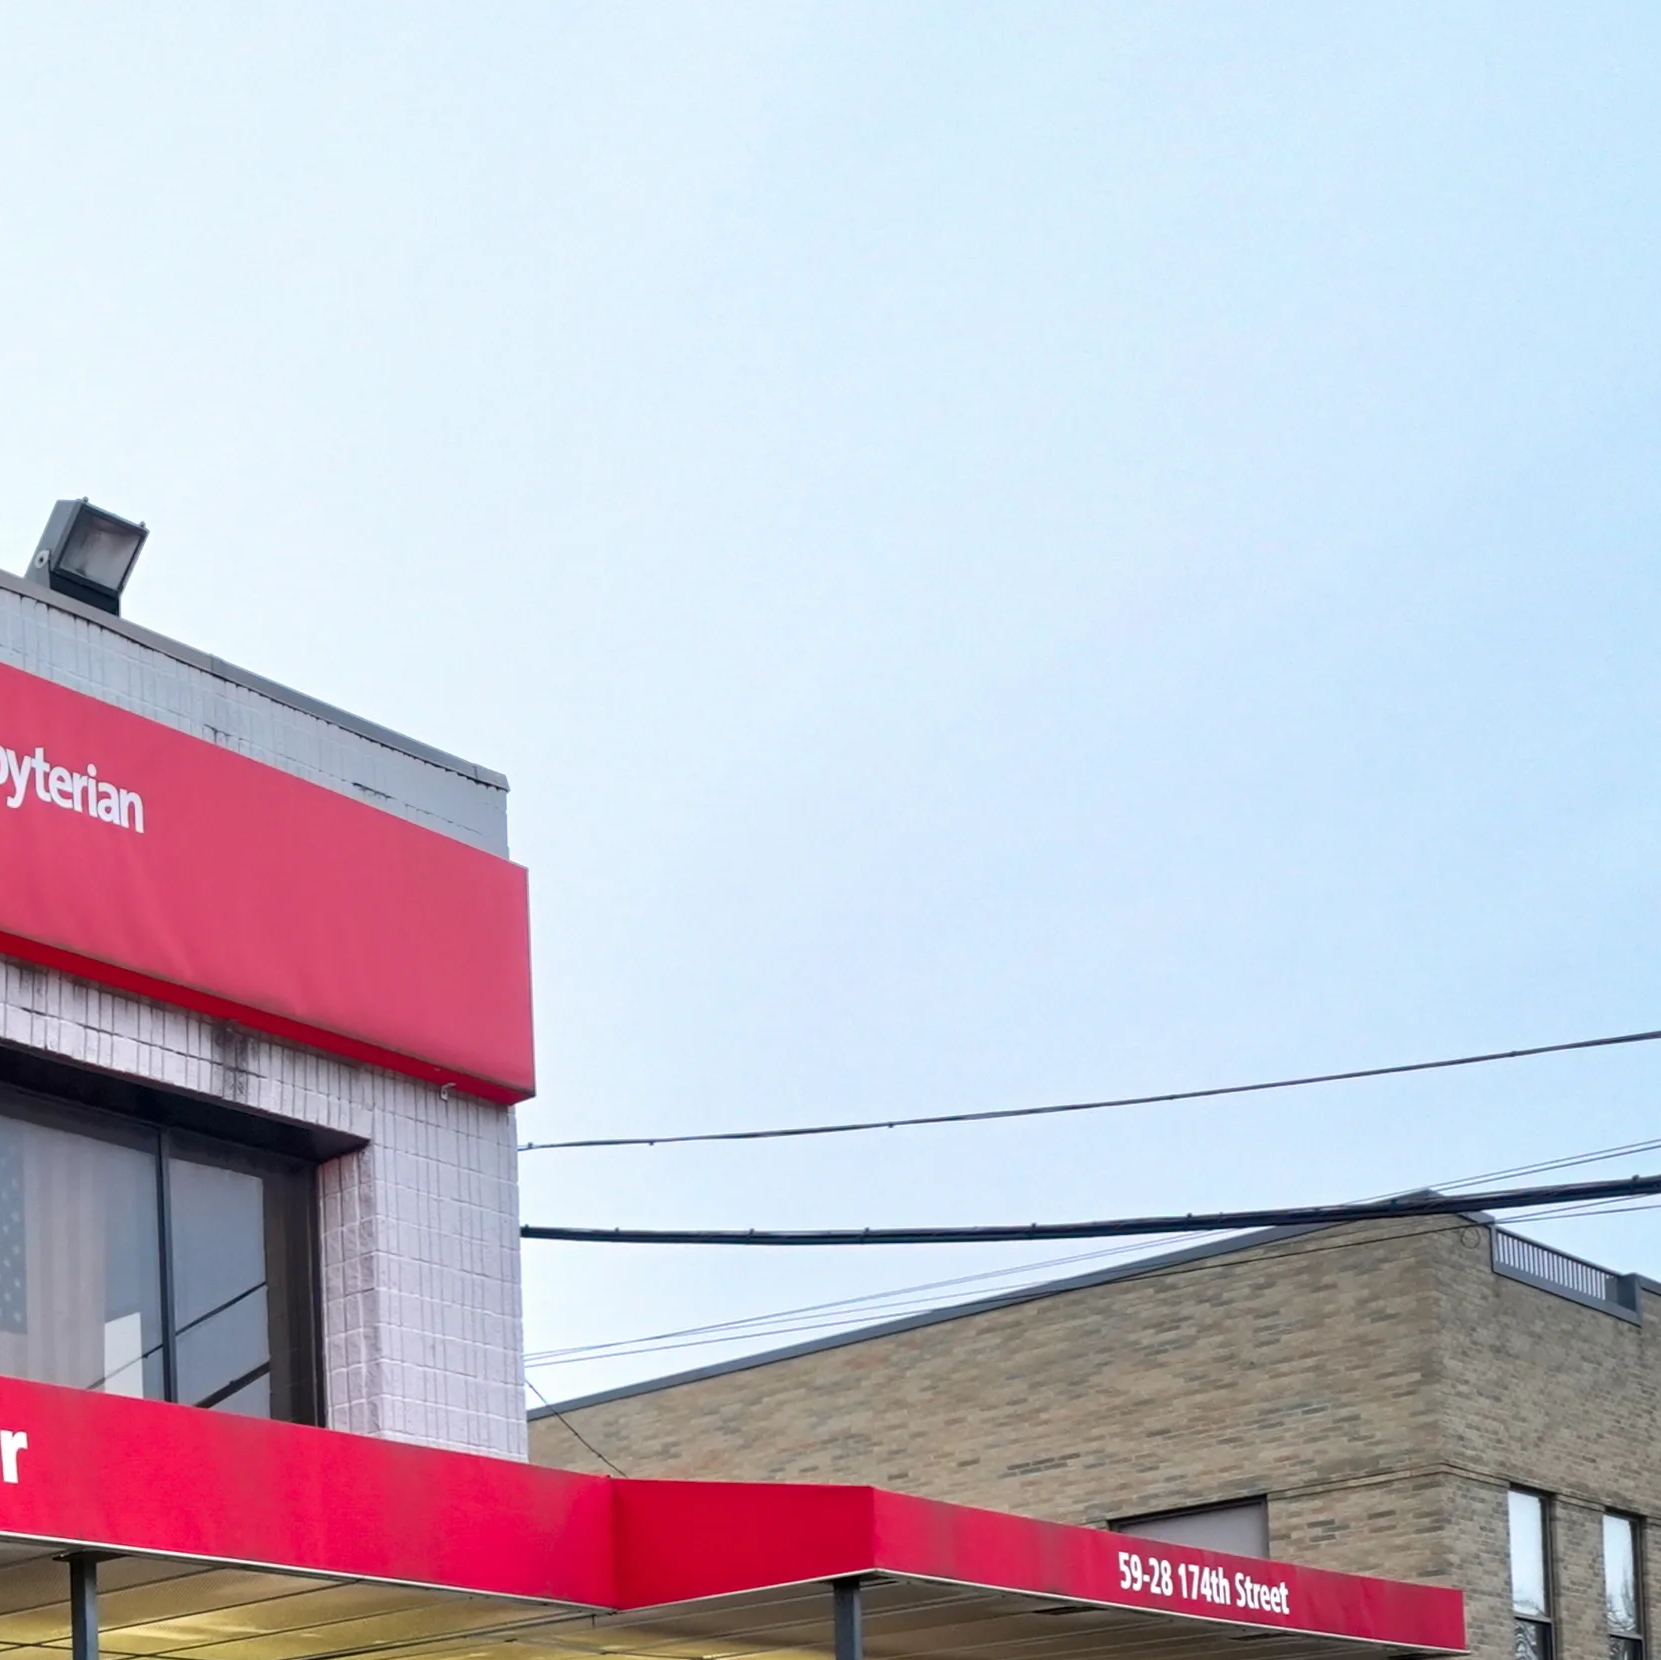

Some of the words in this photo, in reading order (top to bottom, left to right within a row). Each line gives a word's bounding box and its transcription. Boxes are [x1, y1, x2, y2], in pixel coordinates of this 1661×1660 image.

[1118, 1551, 1174, 1597] 59-28
[1177, 1563, 1231, 1605] 174th
[1234, 1572, 1290, 1615] Street
